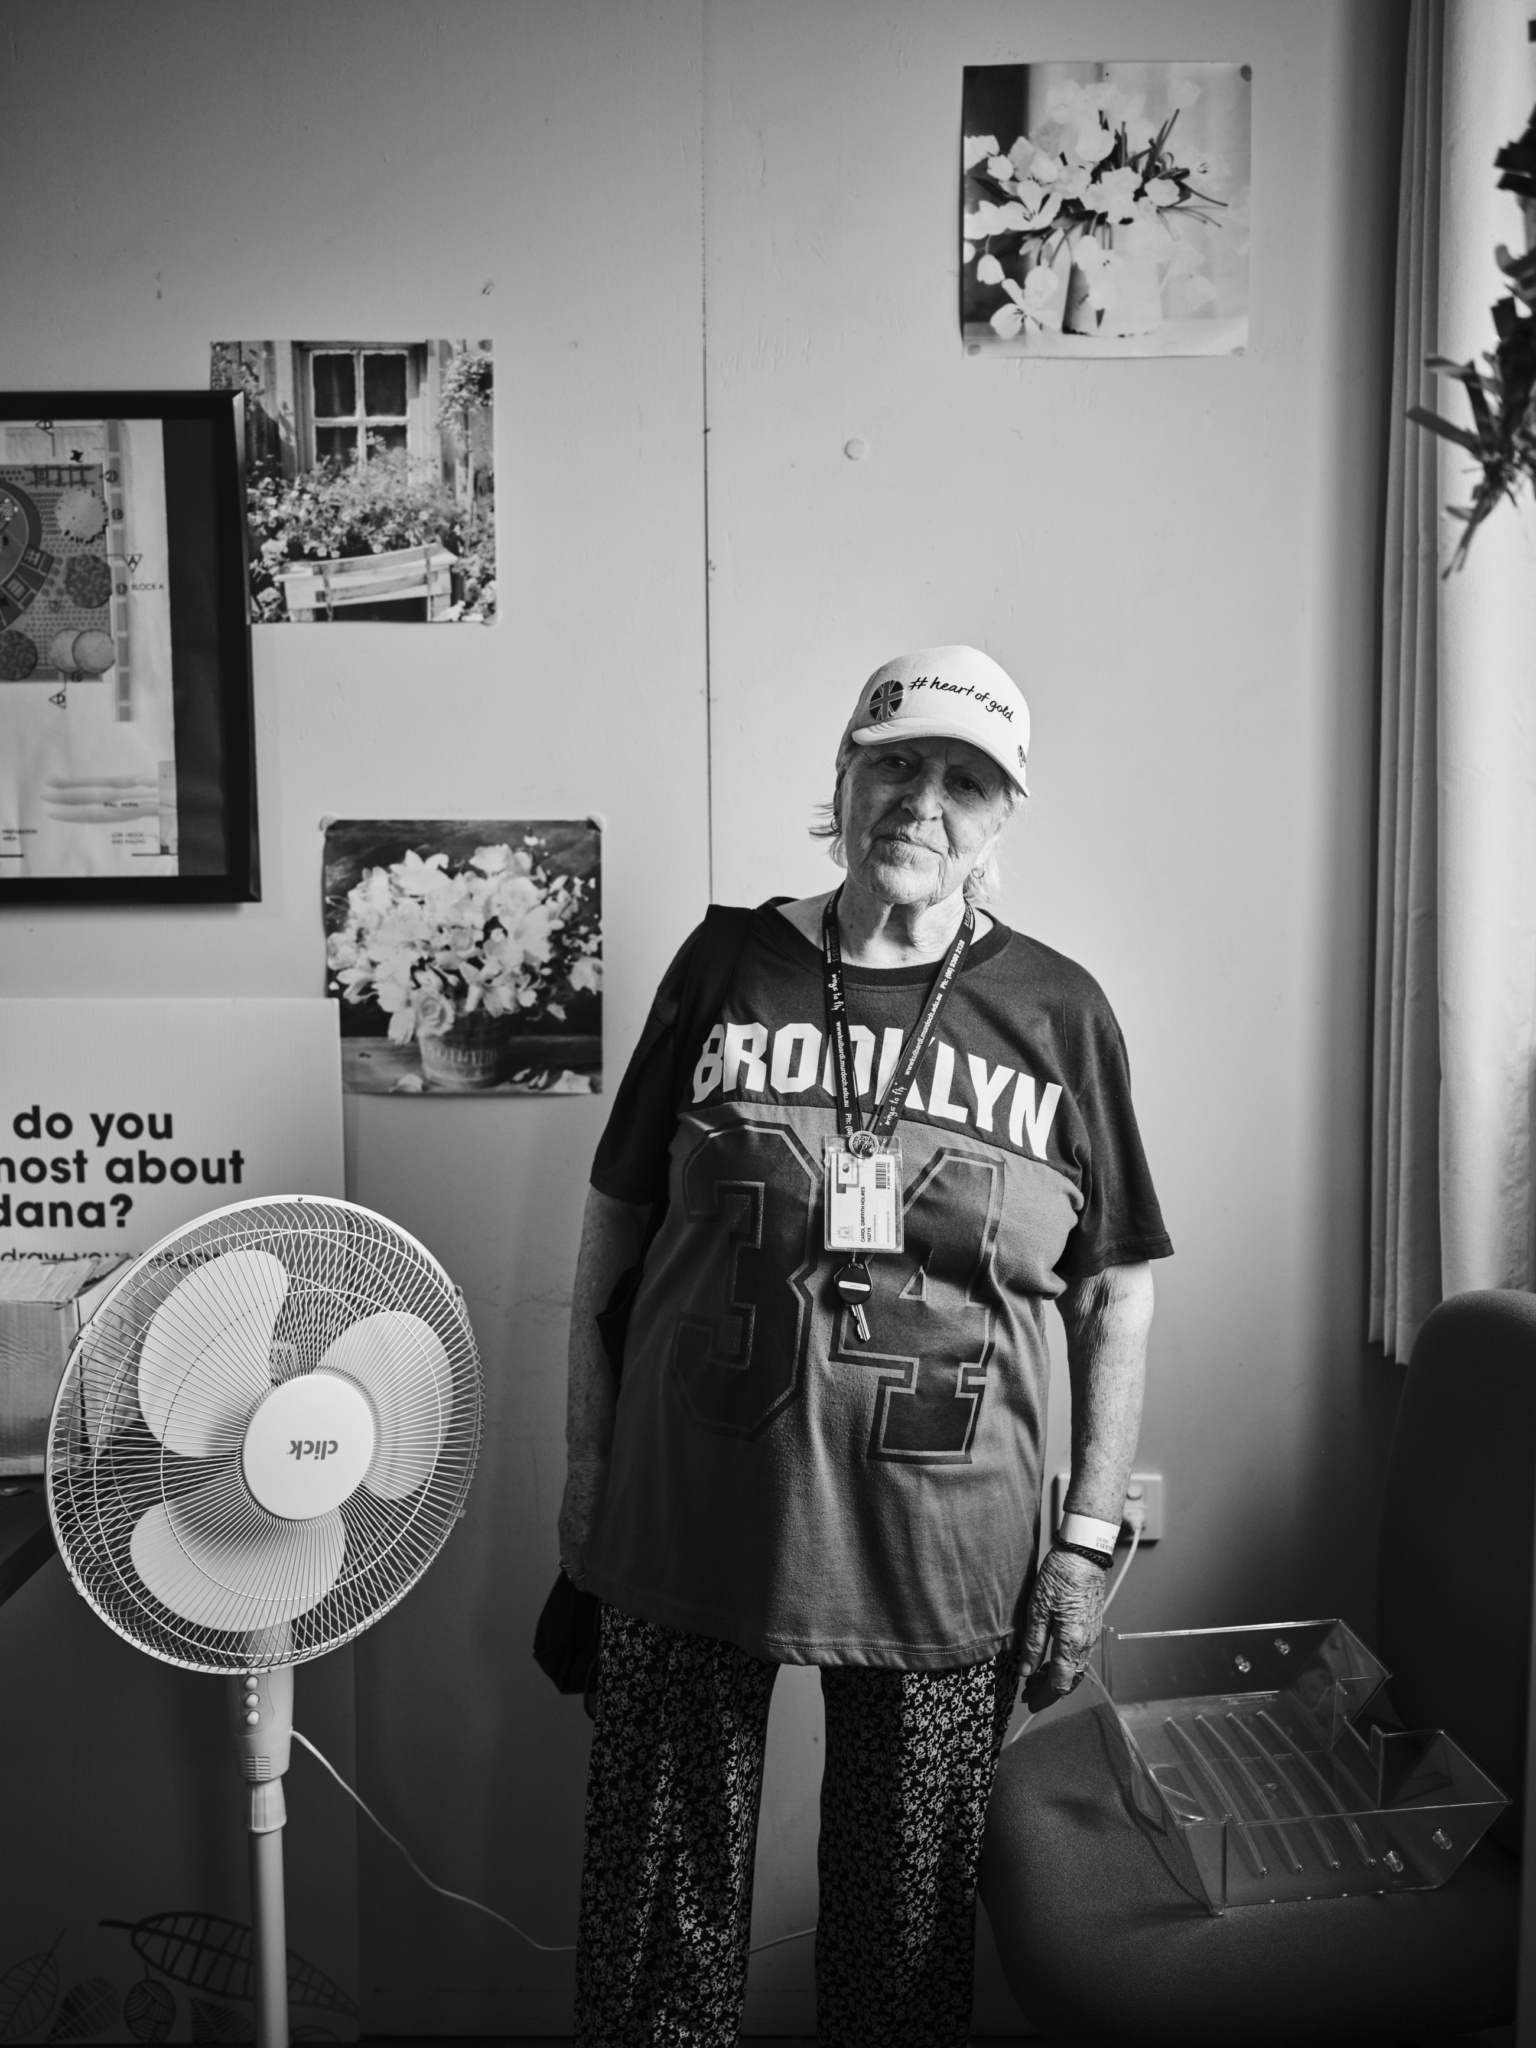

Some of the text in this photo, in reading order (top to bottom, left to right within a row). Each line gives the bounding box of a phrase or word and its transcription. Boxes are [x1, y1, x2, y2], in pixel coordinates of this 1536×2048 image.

[131, 583, 156, 591] BLOCK
[974, 692, 990, 702] of
[985, 700, 1013, 722] gold
[692, 1022, 1062, 1160] BROOKLYN
[13, 1105, 173, 1147] do you
[105, 1150, 245, 1185] about
[288, 1440, 339, 1461] click
